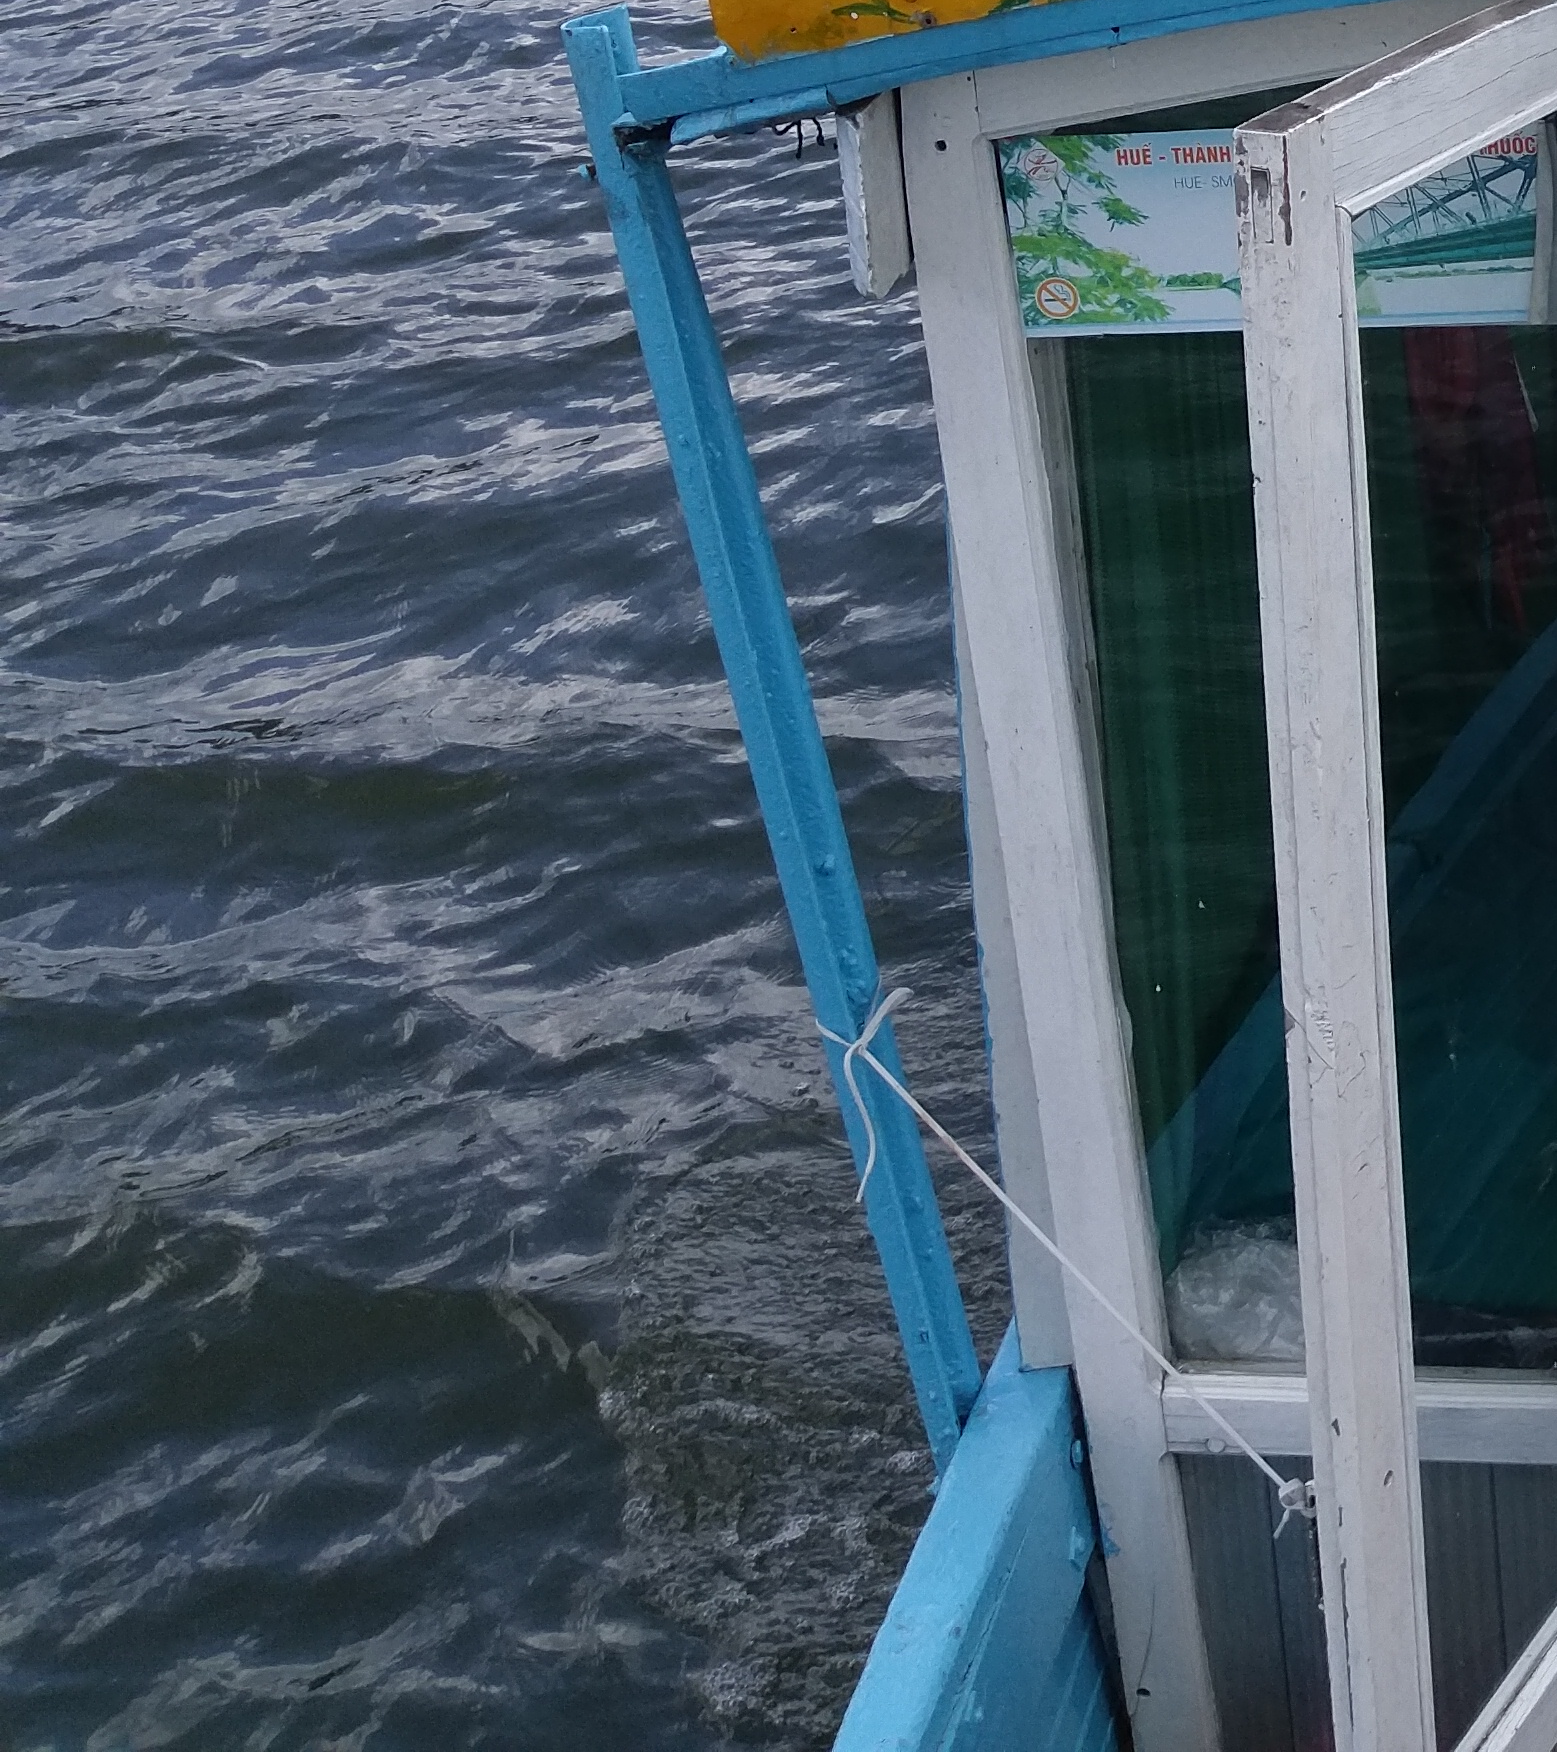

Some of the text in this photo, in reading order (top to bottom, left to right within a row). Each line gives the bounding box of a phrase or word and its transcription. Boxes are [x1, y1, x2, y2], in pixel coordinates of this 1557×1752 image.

[1116, 142, 1153, 166] HUẾ
[1170, 142, 1232, 165] THÀNH
[1211, 175, 1235, 189] SM
